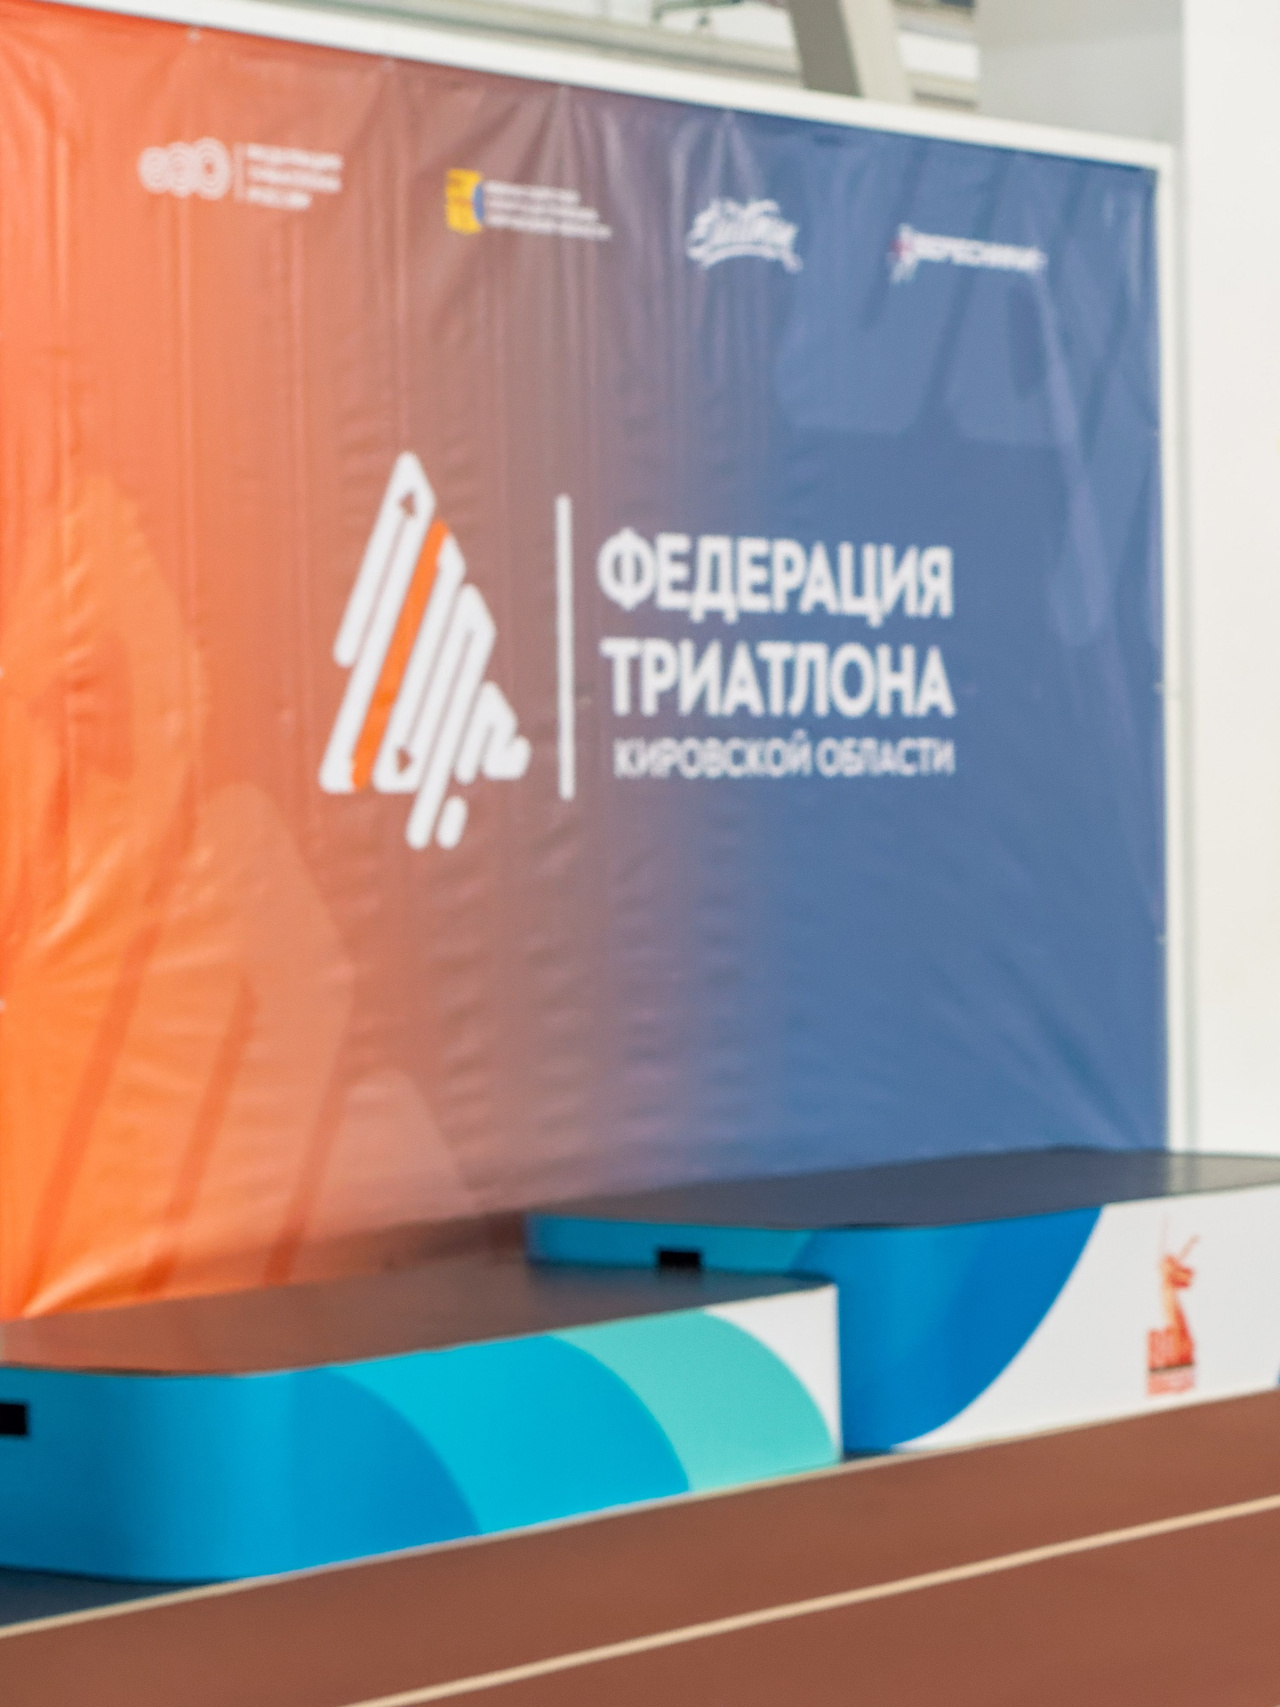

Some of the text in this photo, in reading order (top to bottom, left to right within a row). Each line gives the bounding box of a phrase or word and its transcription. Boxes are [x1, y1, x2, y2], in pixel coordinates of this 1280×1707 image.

[597, 527, 954, 628] ФЕДЕРАЦИЯ
[600, 637, 956, 718] ТРИАТЛОНА
[613, 729, 956, 779] КИРОВСКОЙ ОБЛАСТИ
